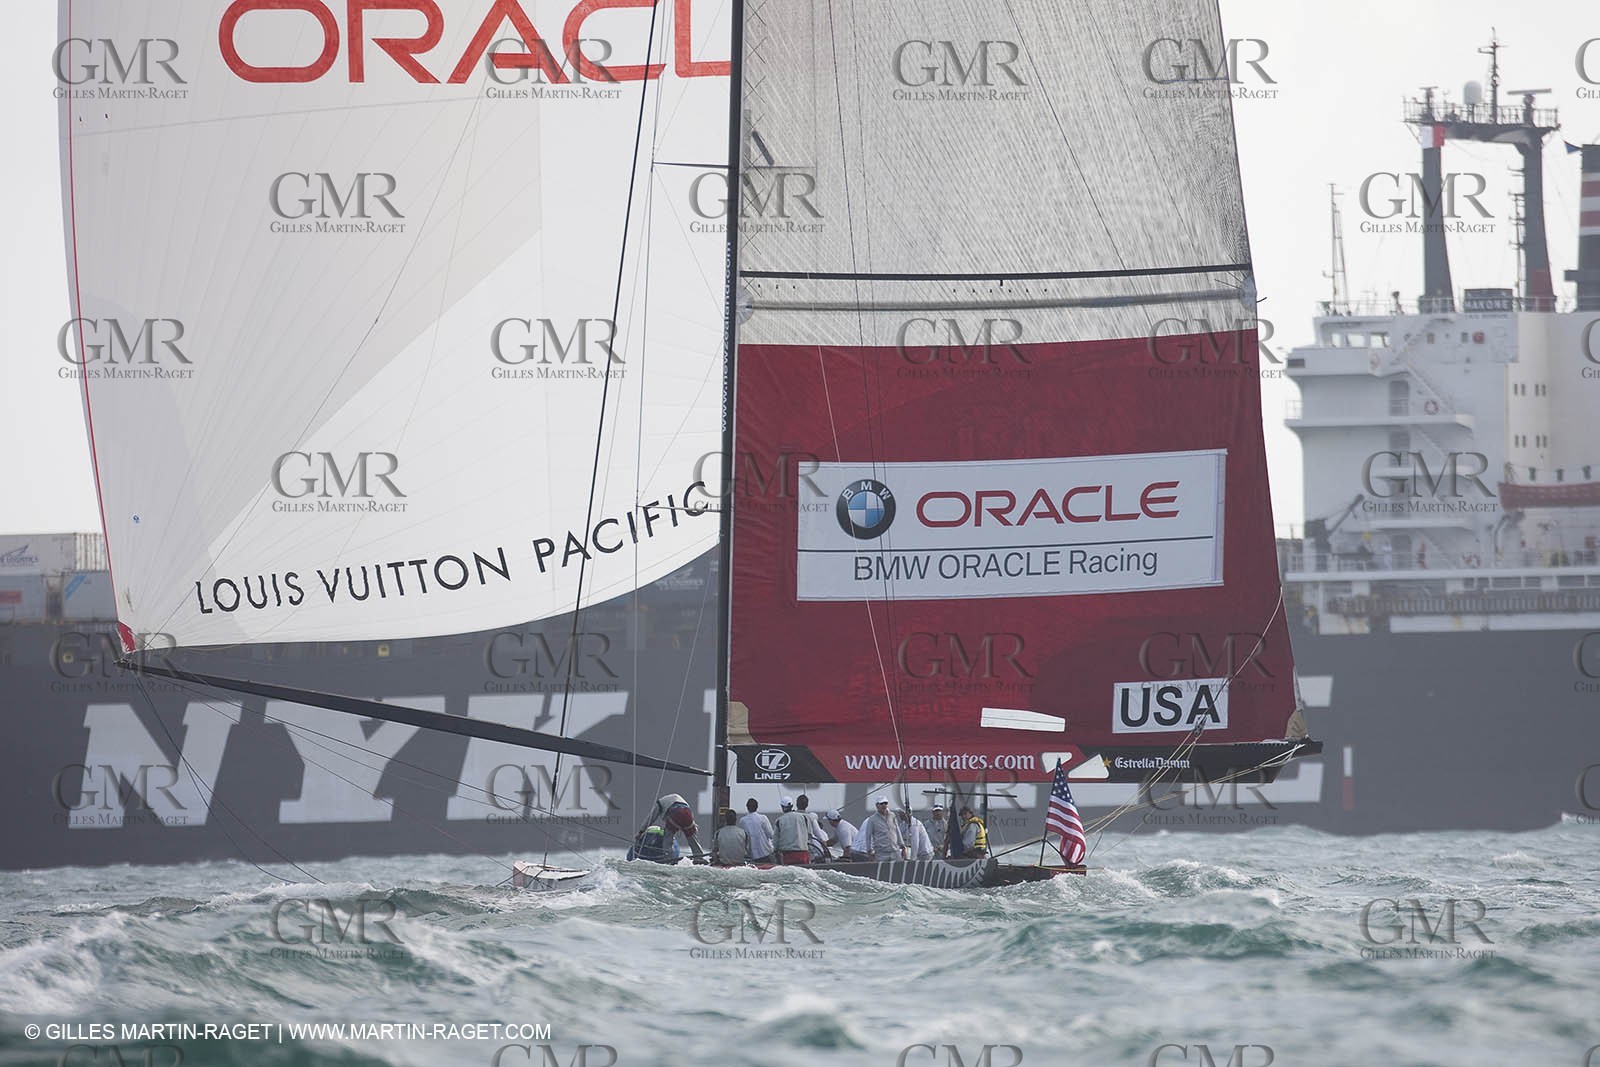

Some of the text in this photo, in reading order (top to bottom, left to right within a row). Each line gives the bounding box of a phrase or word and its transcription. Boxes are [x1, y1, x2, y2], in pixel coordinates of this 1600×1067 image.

[218, 0, 731, 83] ORACL
[841, 480, 892, 500] BMW
[916, 481, 1180, 528] ORACLE
[195, 480, 710, 614] LOUIS VUITTON PACIFIC
[853, 547, 1158, 581] BMW ORACLE Racing
[1120, 684, 1221, 728] USA
[68, 691, 630, 829] NYK
[845, 751, 1036, 770] www.emirates.com
